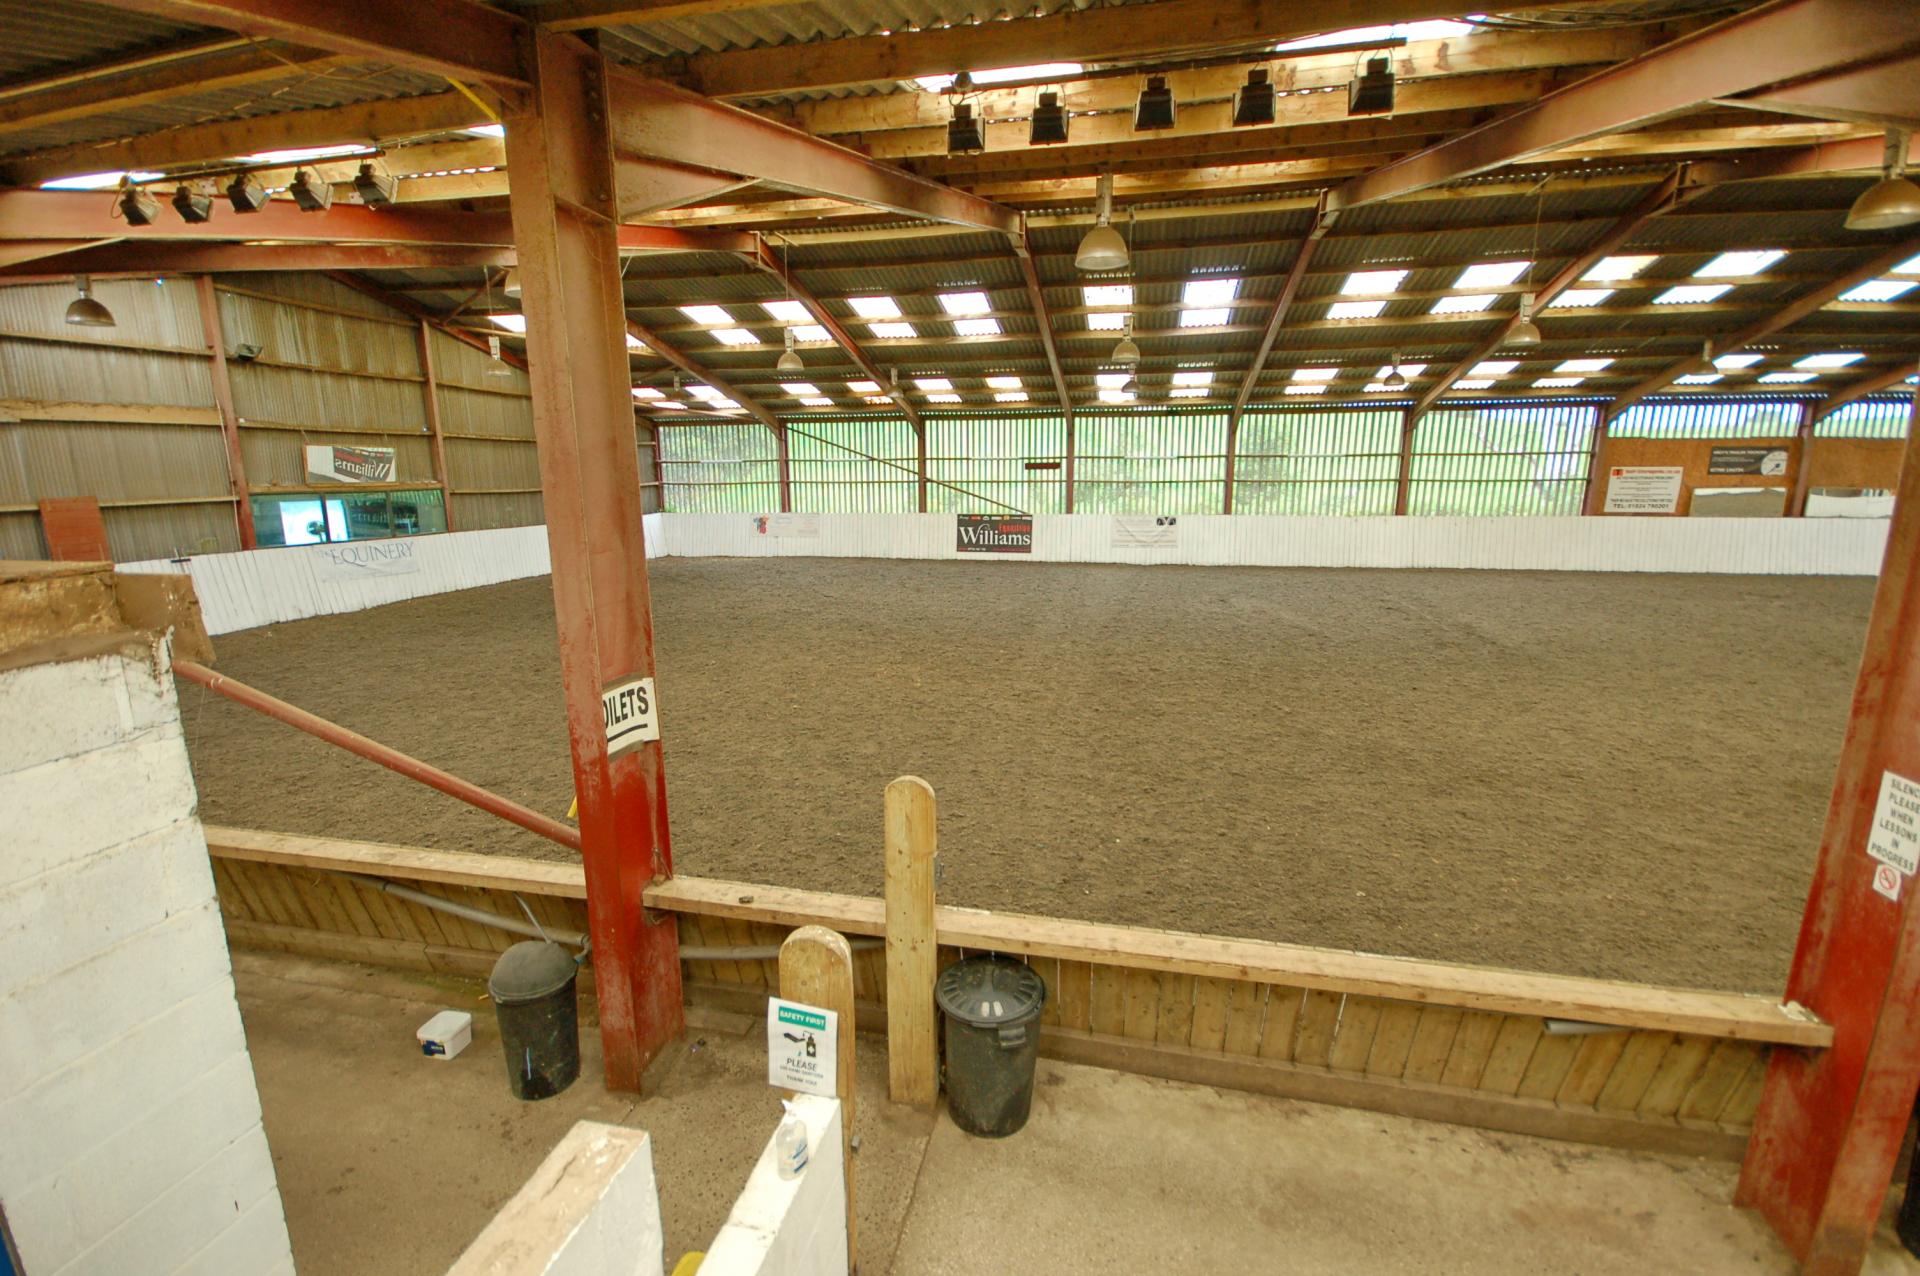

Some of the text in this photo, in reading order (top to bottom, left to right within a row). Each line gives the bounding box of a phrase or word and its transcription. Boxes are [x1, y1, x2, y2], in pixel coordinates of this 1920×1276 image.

[959, 523, 1031, 545] Williams
[331, 541, 414, 567] EQUINERY
[603, 687, 649, 728] ILETS
[1891, 778, 1920, 799] SILENC
[1890, 808, 1914, 827] WHEN
[1880, 817, 1917, 843] LESSONS
[1871, 842, 1914, 872] PROGRESS
[780, 1010, 826, 1027] SAFETY FIRST
[786, 1057, 817, 1073] PLEASE
